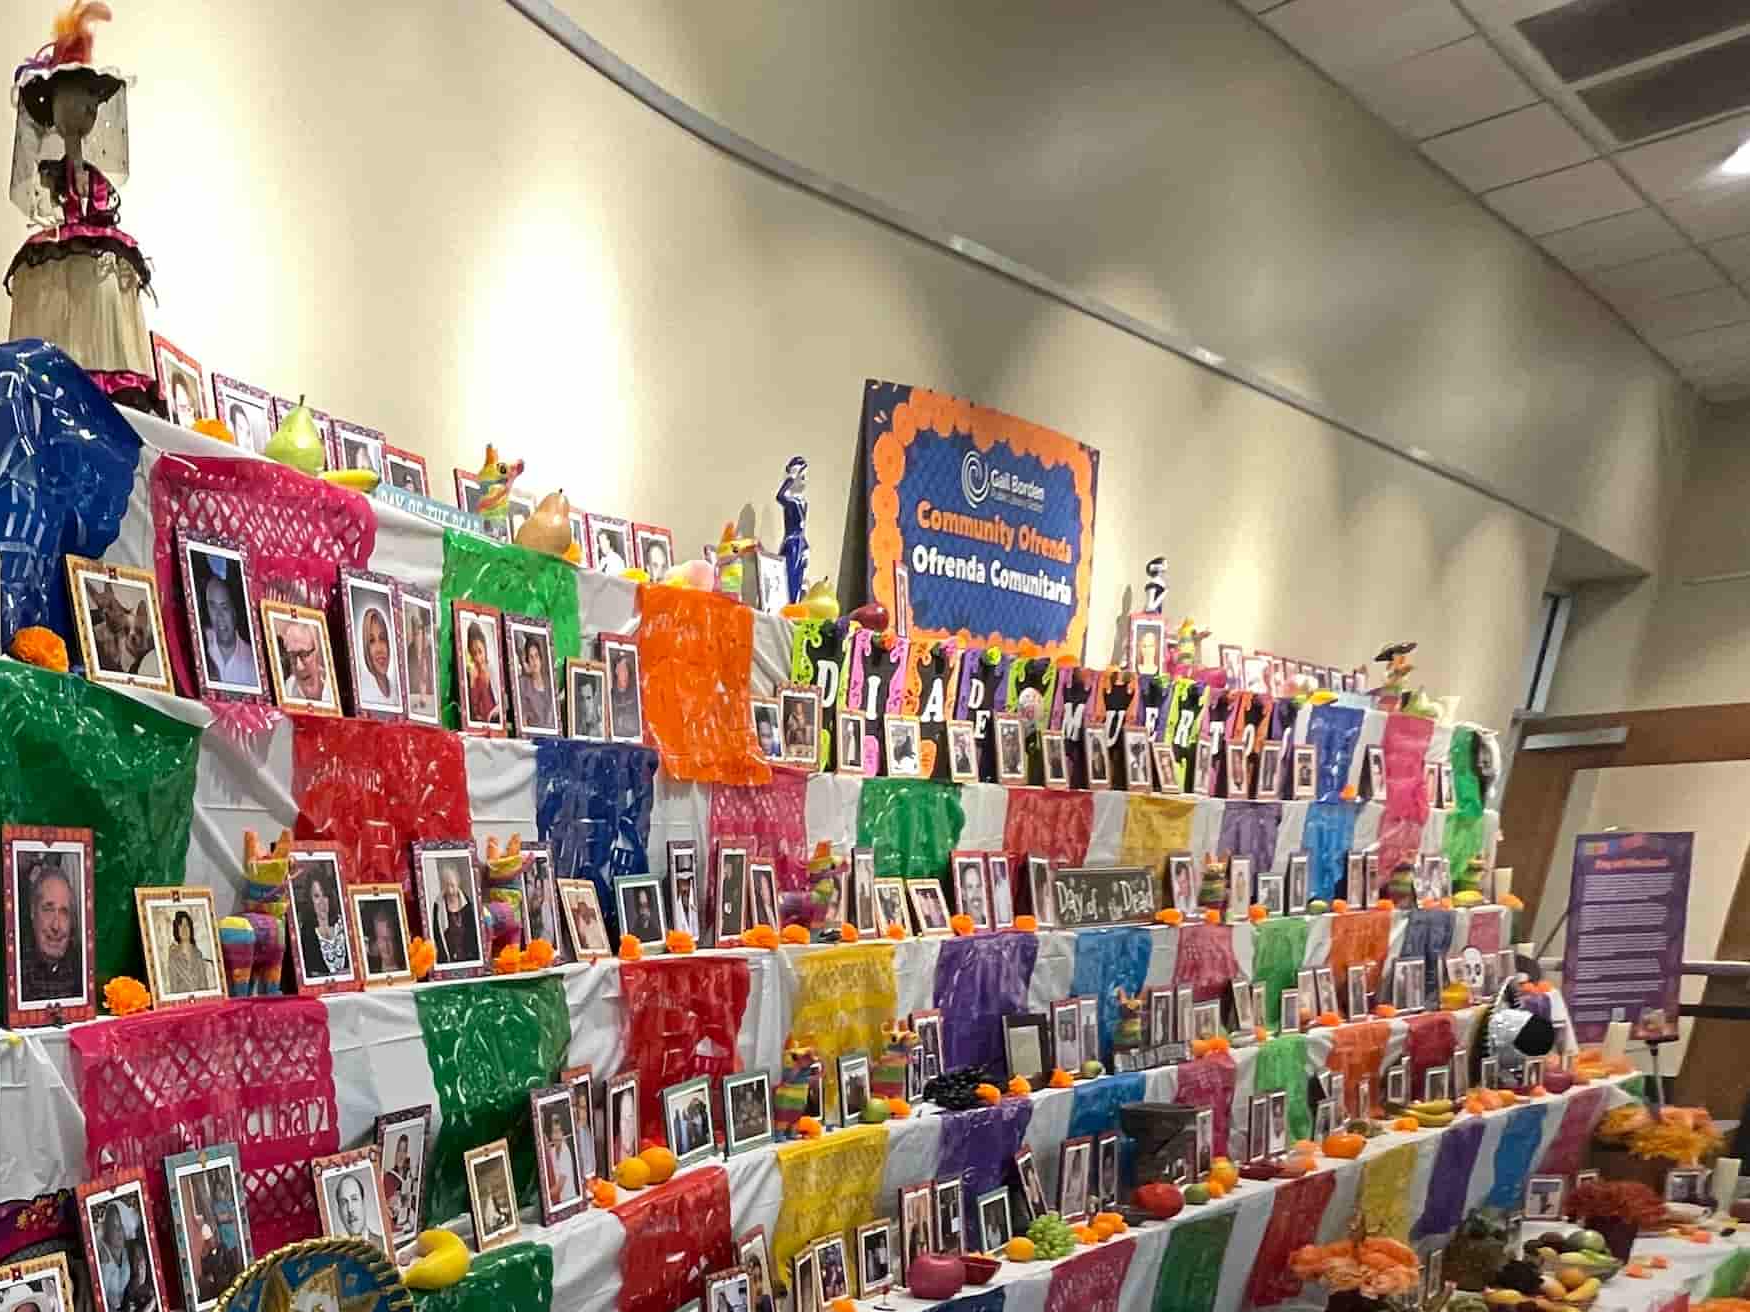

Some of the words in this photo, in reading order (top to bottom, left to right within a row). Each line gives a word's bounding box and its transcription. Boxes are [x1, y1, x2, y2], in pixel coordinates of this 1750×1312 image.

[917, 499, 1015, 553] Community
[1018, 524, 1073, 565] Ofrenda
[911, 544, 987, 585] Ofrenda
[990, 559, 1072, 606] Comunitaria
